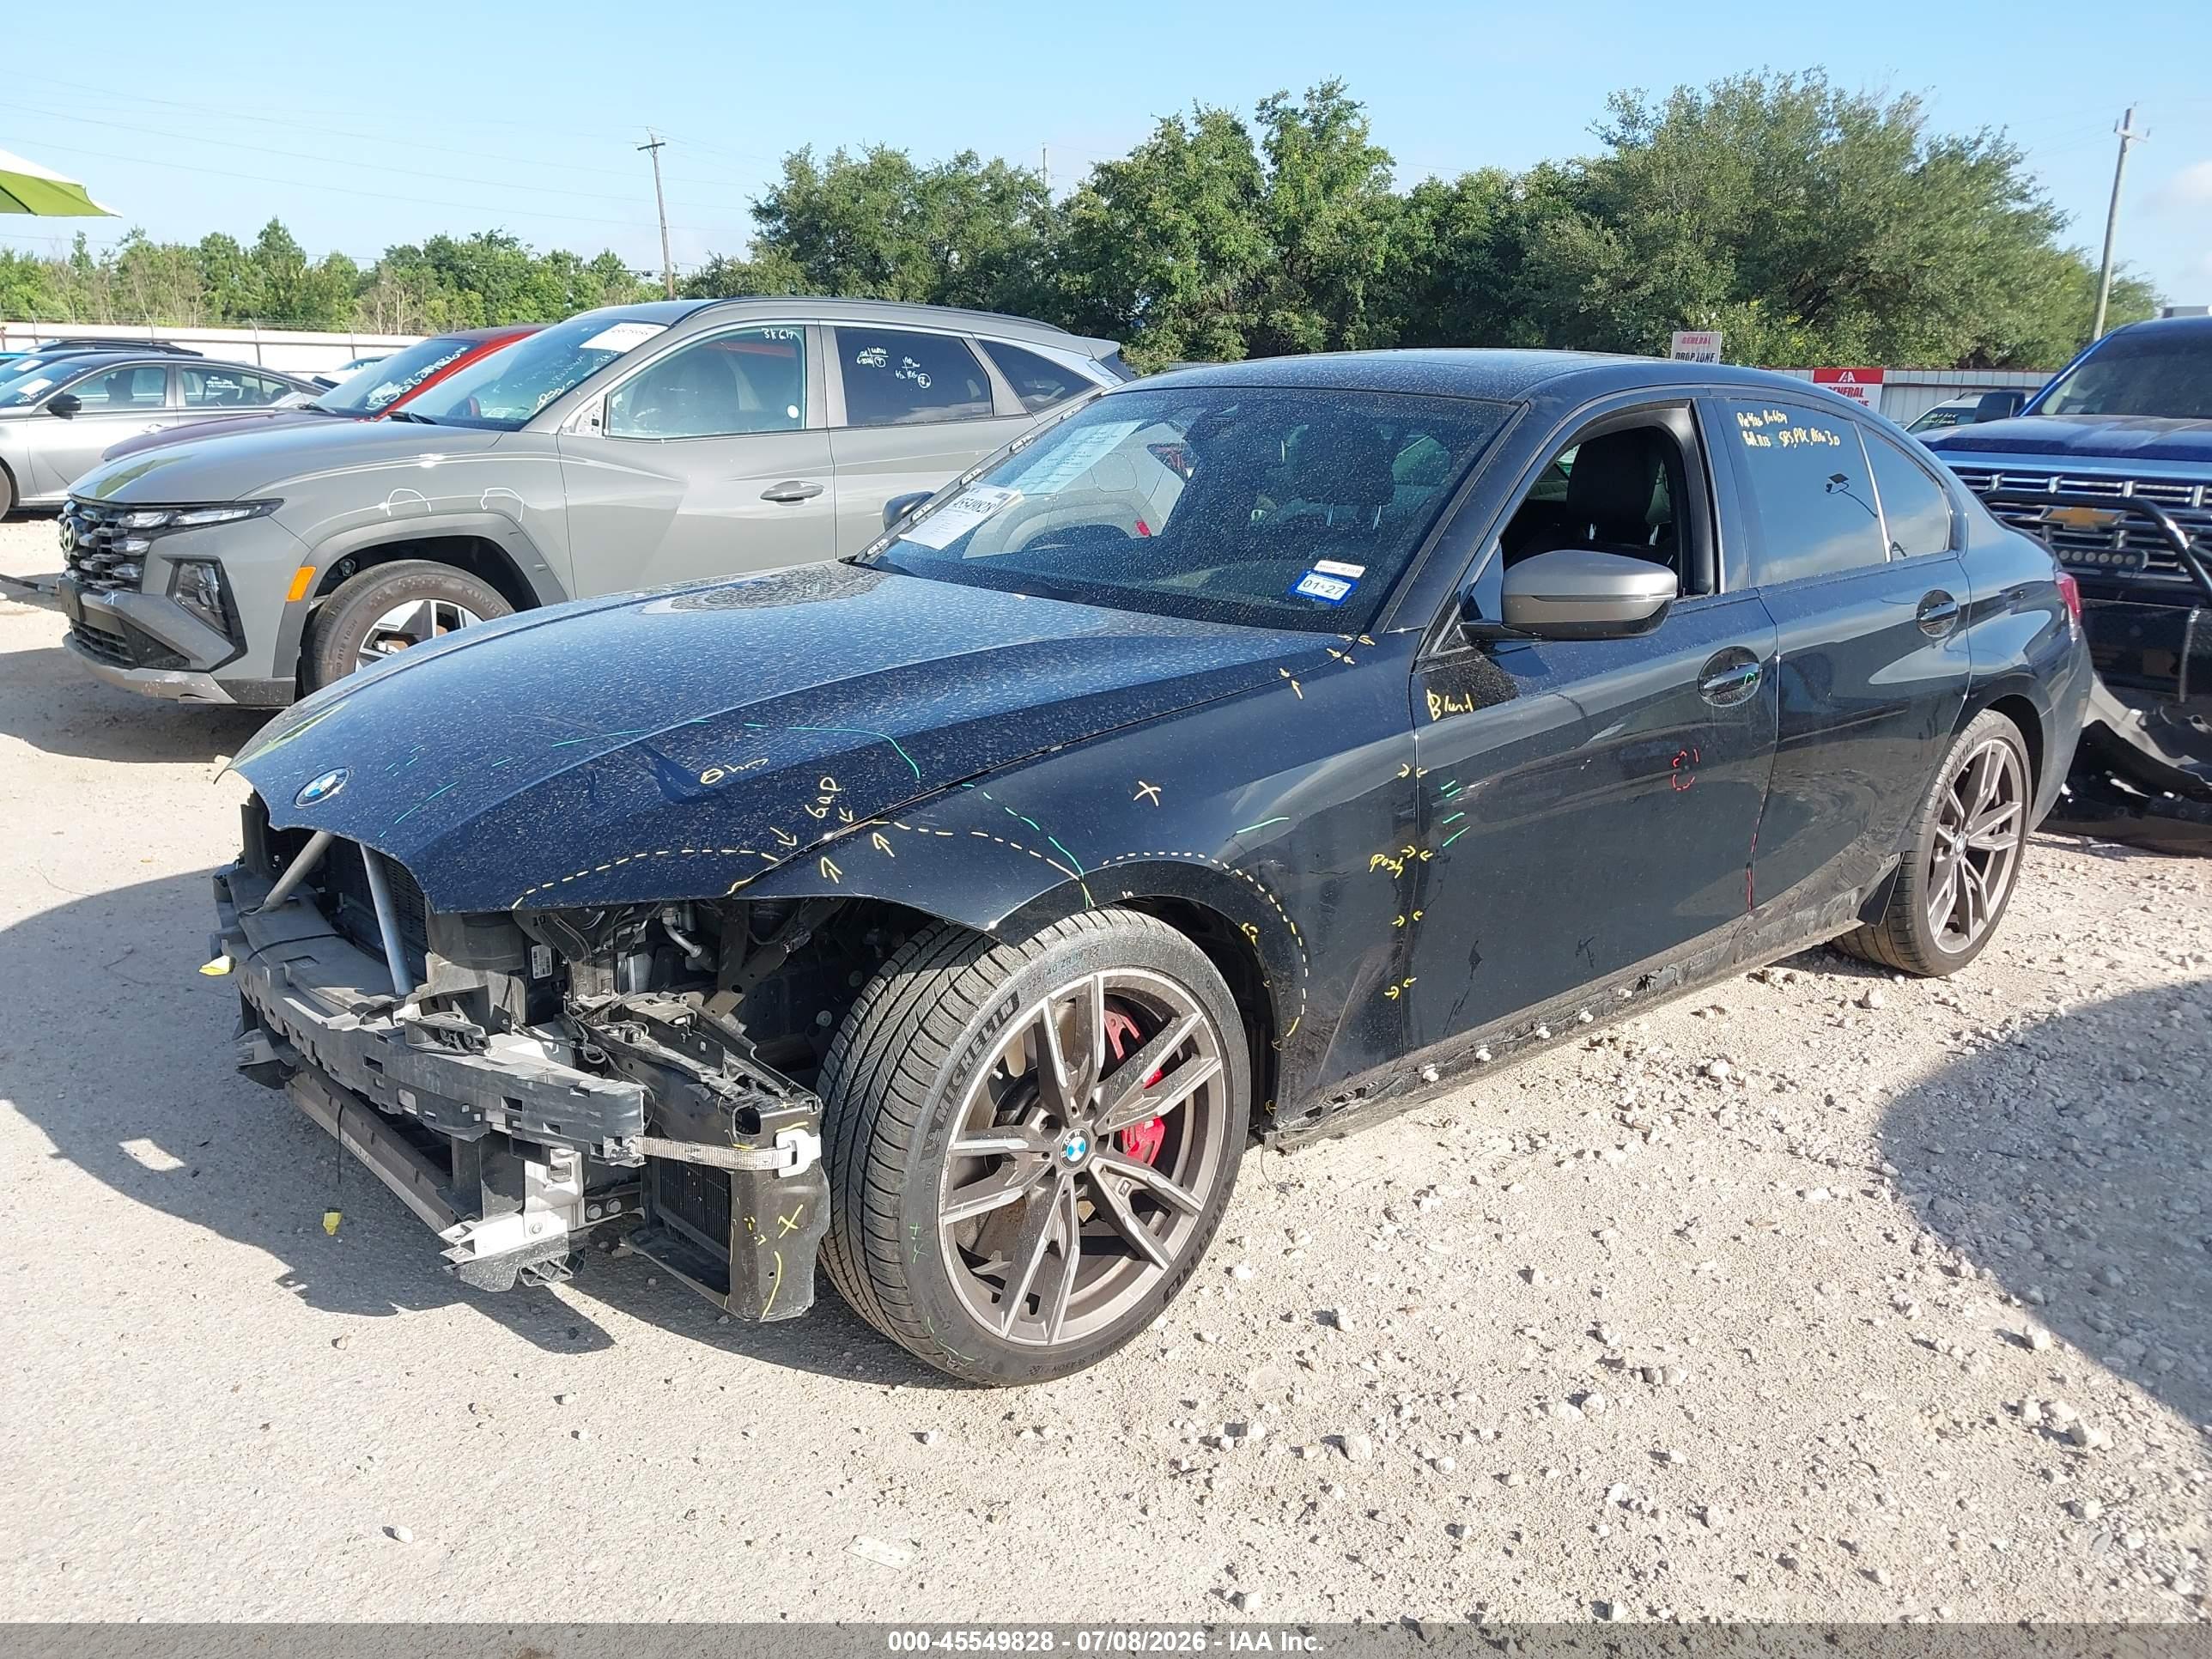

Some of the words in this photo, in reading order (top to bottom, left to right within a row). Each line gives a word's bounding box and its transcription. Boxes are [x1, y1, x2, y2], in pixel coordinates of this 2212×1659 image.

[1675, 352, 1695, 362] DROP
[1827, 386, 1864, 398] NERAL
[936, 997, 1017, 1124] MICHELIN
